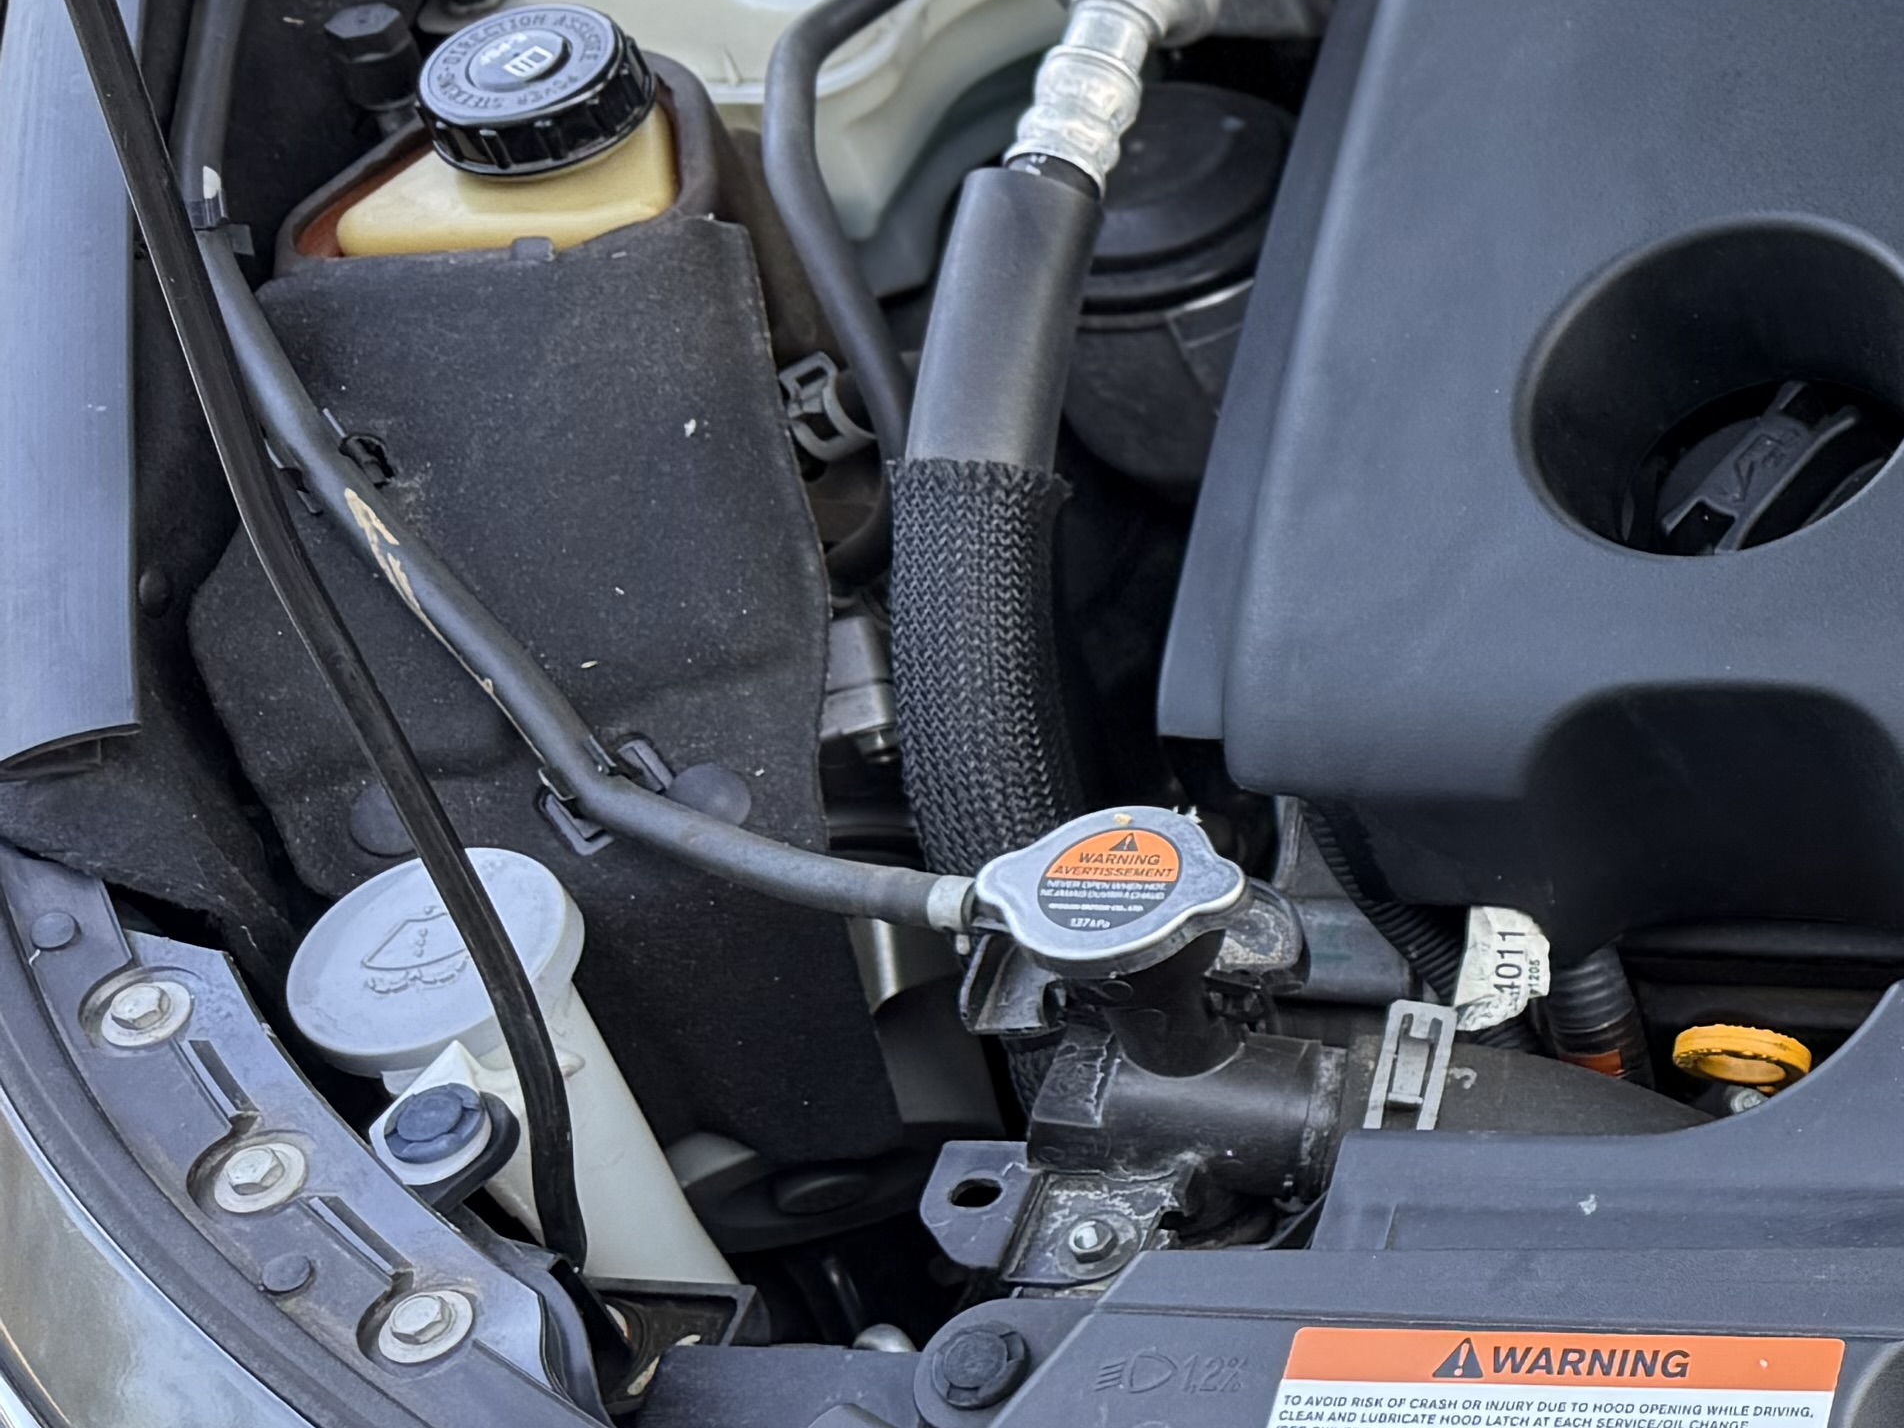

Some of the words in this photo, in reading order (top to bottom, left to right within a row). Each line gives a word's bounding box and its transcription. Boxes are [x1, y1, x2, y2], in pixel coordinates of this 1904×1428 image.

[1078, 852, 1161, 865] WARNING
[1053, 866, 1175, 878] AVERTISSEMENT
[1492, 1346, 1692, 1378] WARNING
[1284, 1395, 1302, 1406] TO
[1304, 1396, 1347, 1406] AVOID
[1351, 1397, 1383, 1408] RISK
[1387, 1398, 1406, 1408] OF
[1409, 1398, 1458, 1409] CRASH
[1461, 1399, 1482, 1410] OR
[1485, 1400, 1534, 1411] INJURY
[1537, 1401, 1567, 1412] DUE
[1571, 1402, 1588, 1412] TO
[1592, 1403, 1635, 1413] HOOD
[1639, 1404, 1702, 1415] OPENING
[1707, 1405, 1750, 1416] WHILE
[1278, 1411, 1324, 1421] CLEAN
[1326, 1412, 1357, 1422] AND
[1360, 1413, 1436, 1424] LUBRICATE
[1439, 1415, 1482, 1425] HOOD
[1485, 1415, 1530, 1426] LATCH
[1532, 1416, 1550, 1426] AT
[1553, 1417, 1592, 1428] EACH
